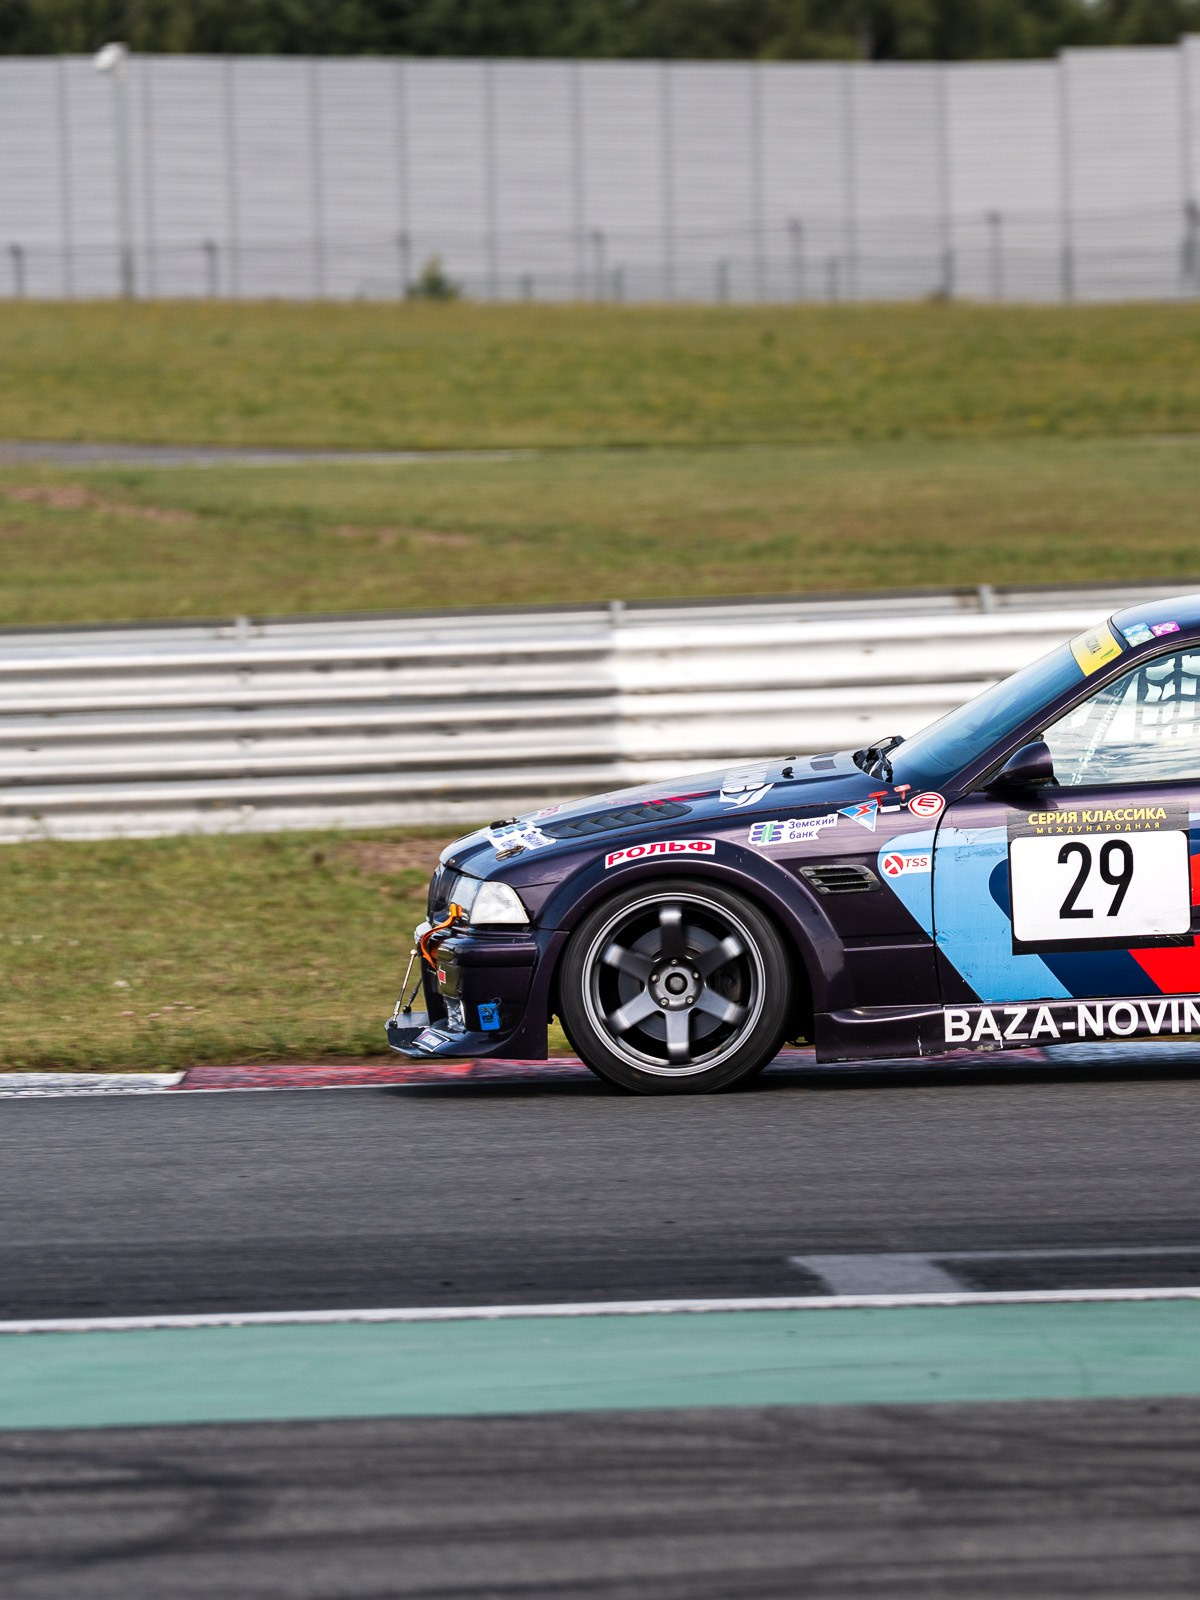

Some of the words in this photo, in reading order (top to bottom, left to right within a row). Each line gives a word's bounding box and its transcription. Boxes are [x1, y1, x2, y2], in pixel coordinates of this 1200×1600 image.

[788, 816, 835, 829] Земский
[1028, 814, 1078, 825] СЕРИЯ
[1082, 808, 1167, 823] КЛАССИКА
[1036, 822, 1161, 834] МЕЖДУНАРОДНАЯ
[789, 830, 814, 840] банк
[607, 840, 713, 866] РОЛЬФ
[905, 857, 928, 868] TSS
[1057, 839, 1135, 919] 29
